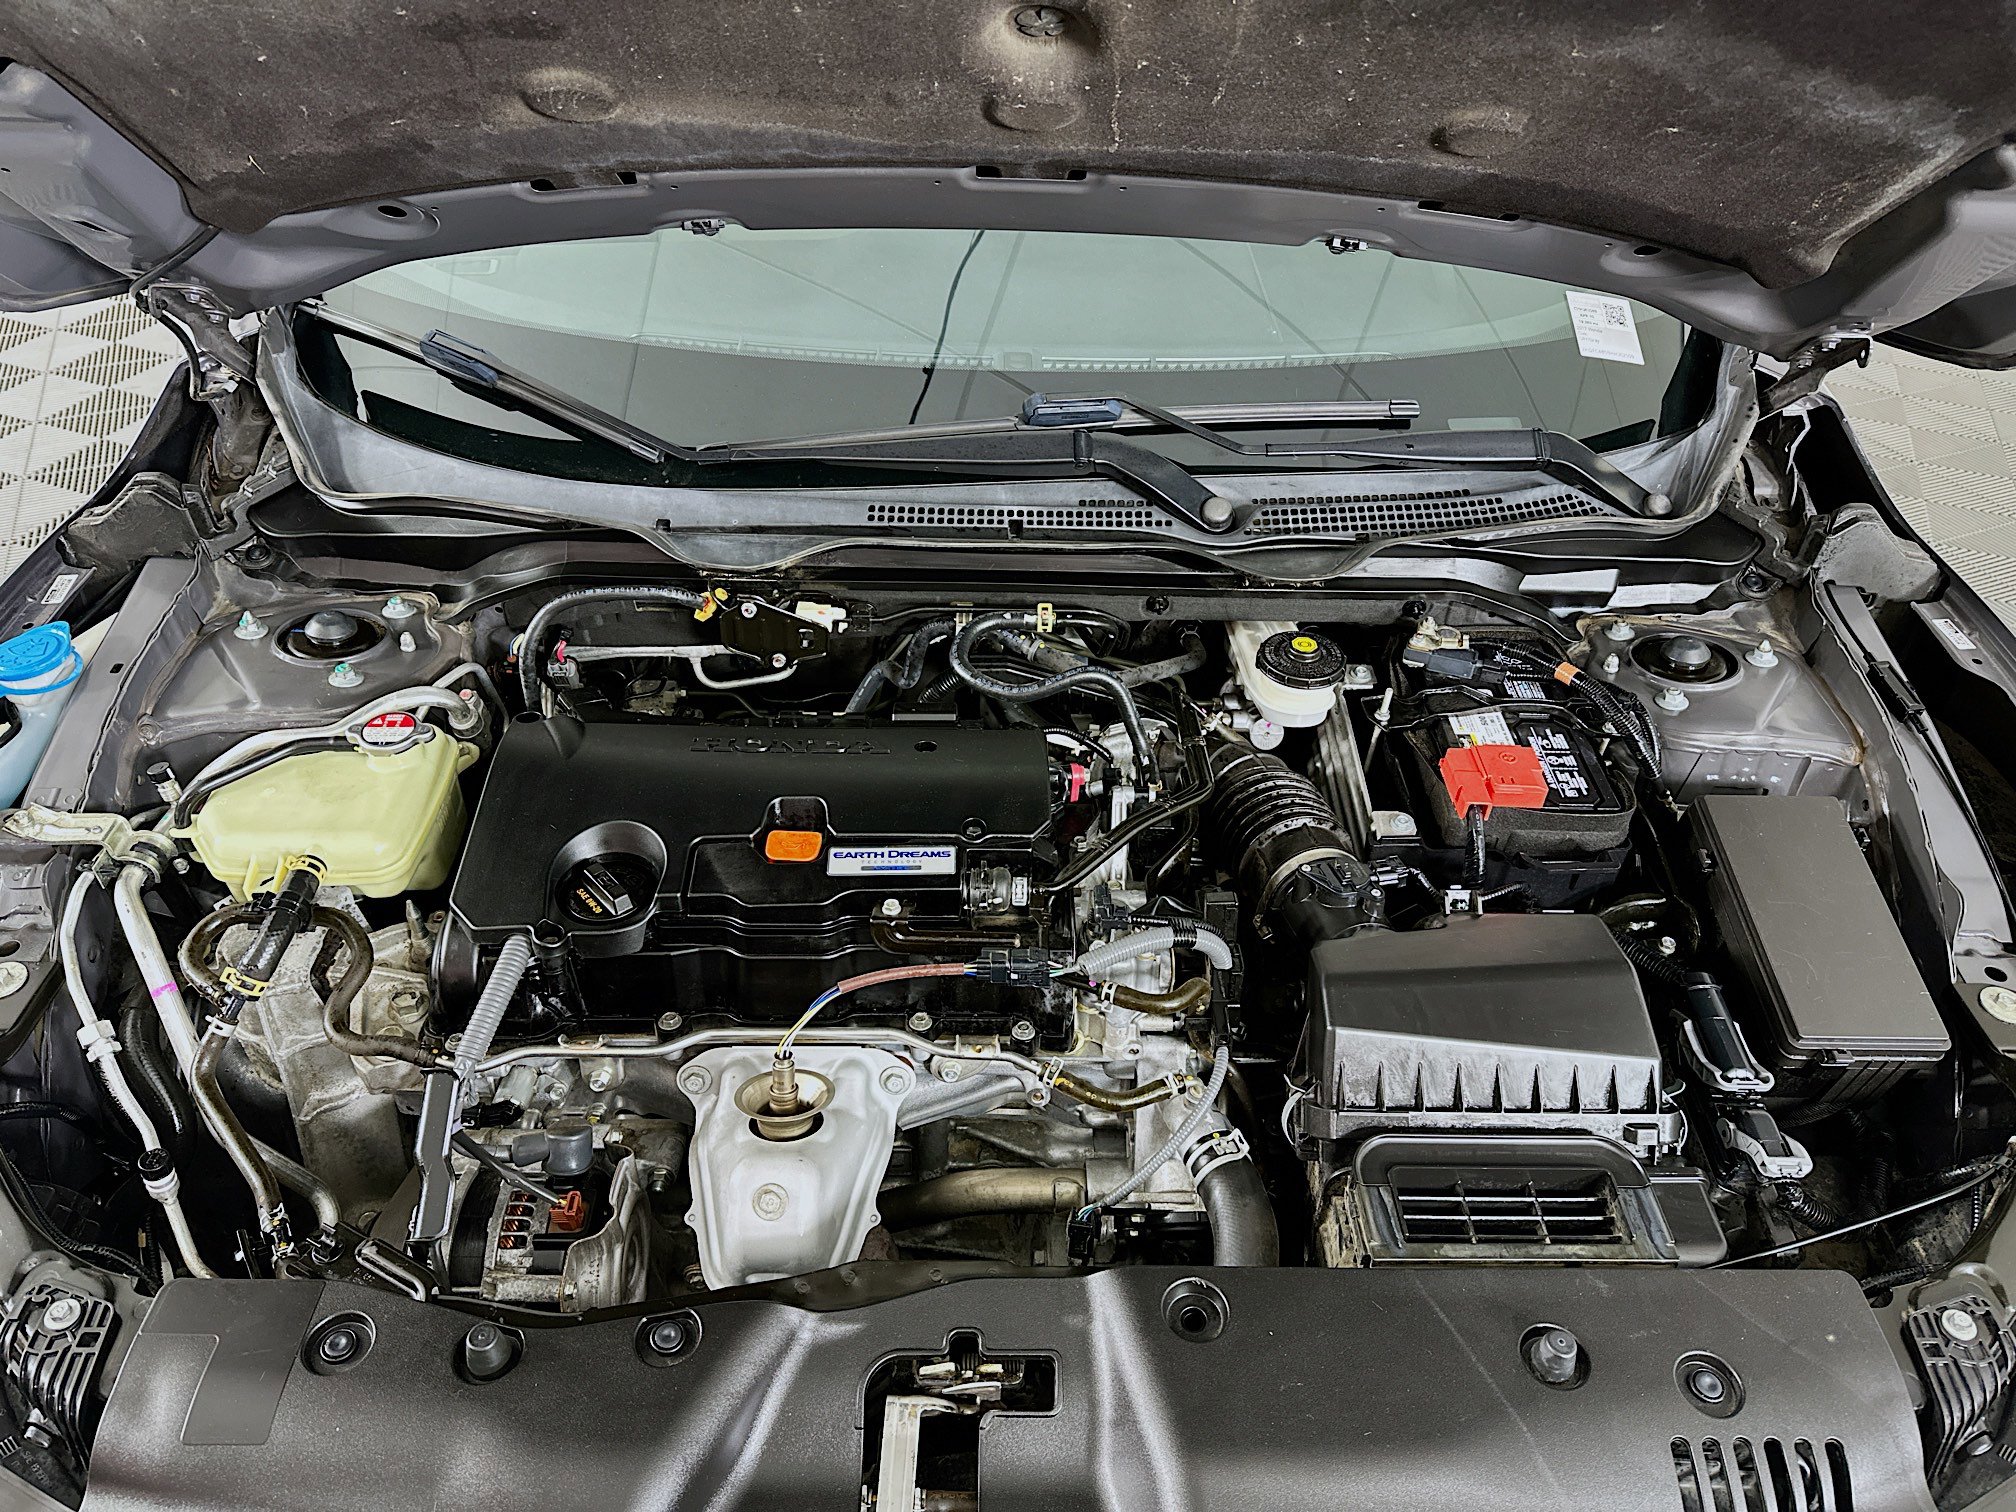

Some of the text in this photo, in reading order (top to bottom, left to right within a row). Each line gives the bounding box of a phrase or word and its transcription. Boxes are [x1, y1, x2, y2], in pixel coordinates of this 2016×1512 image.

[690, 737, 890, 755] HONDA
[832, 850, 952, 859] EARTH DREAMS
[576, 888, 590, 900] SAE
